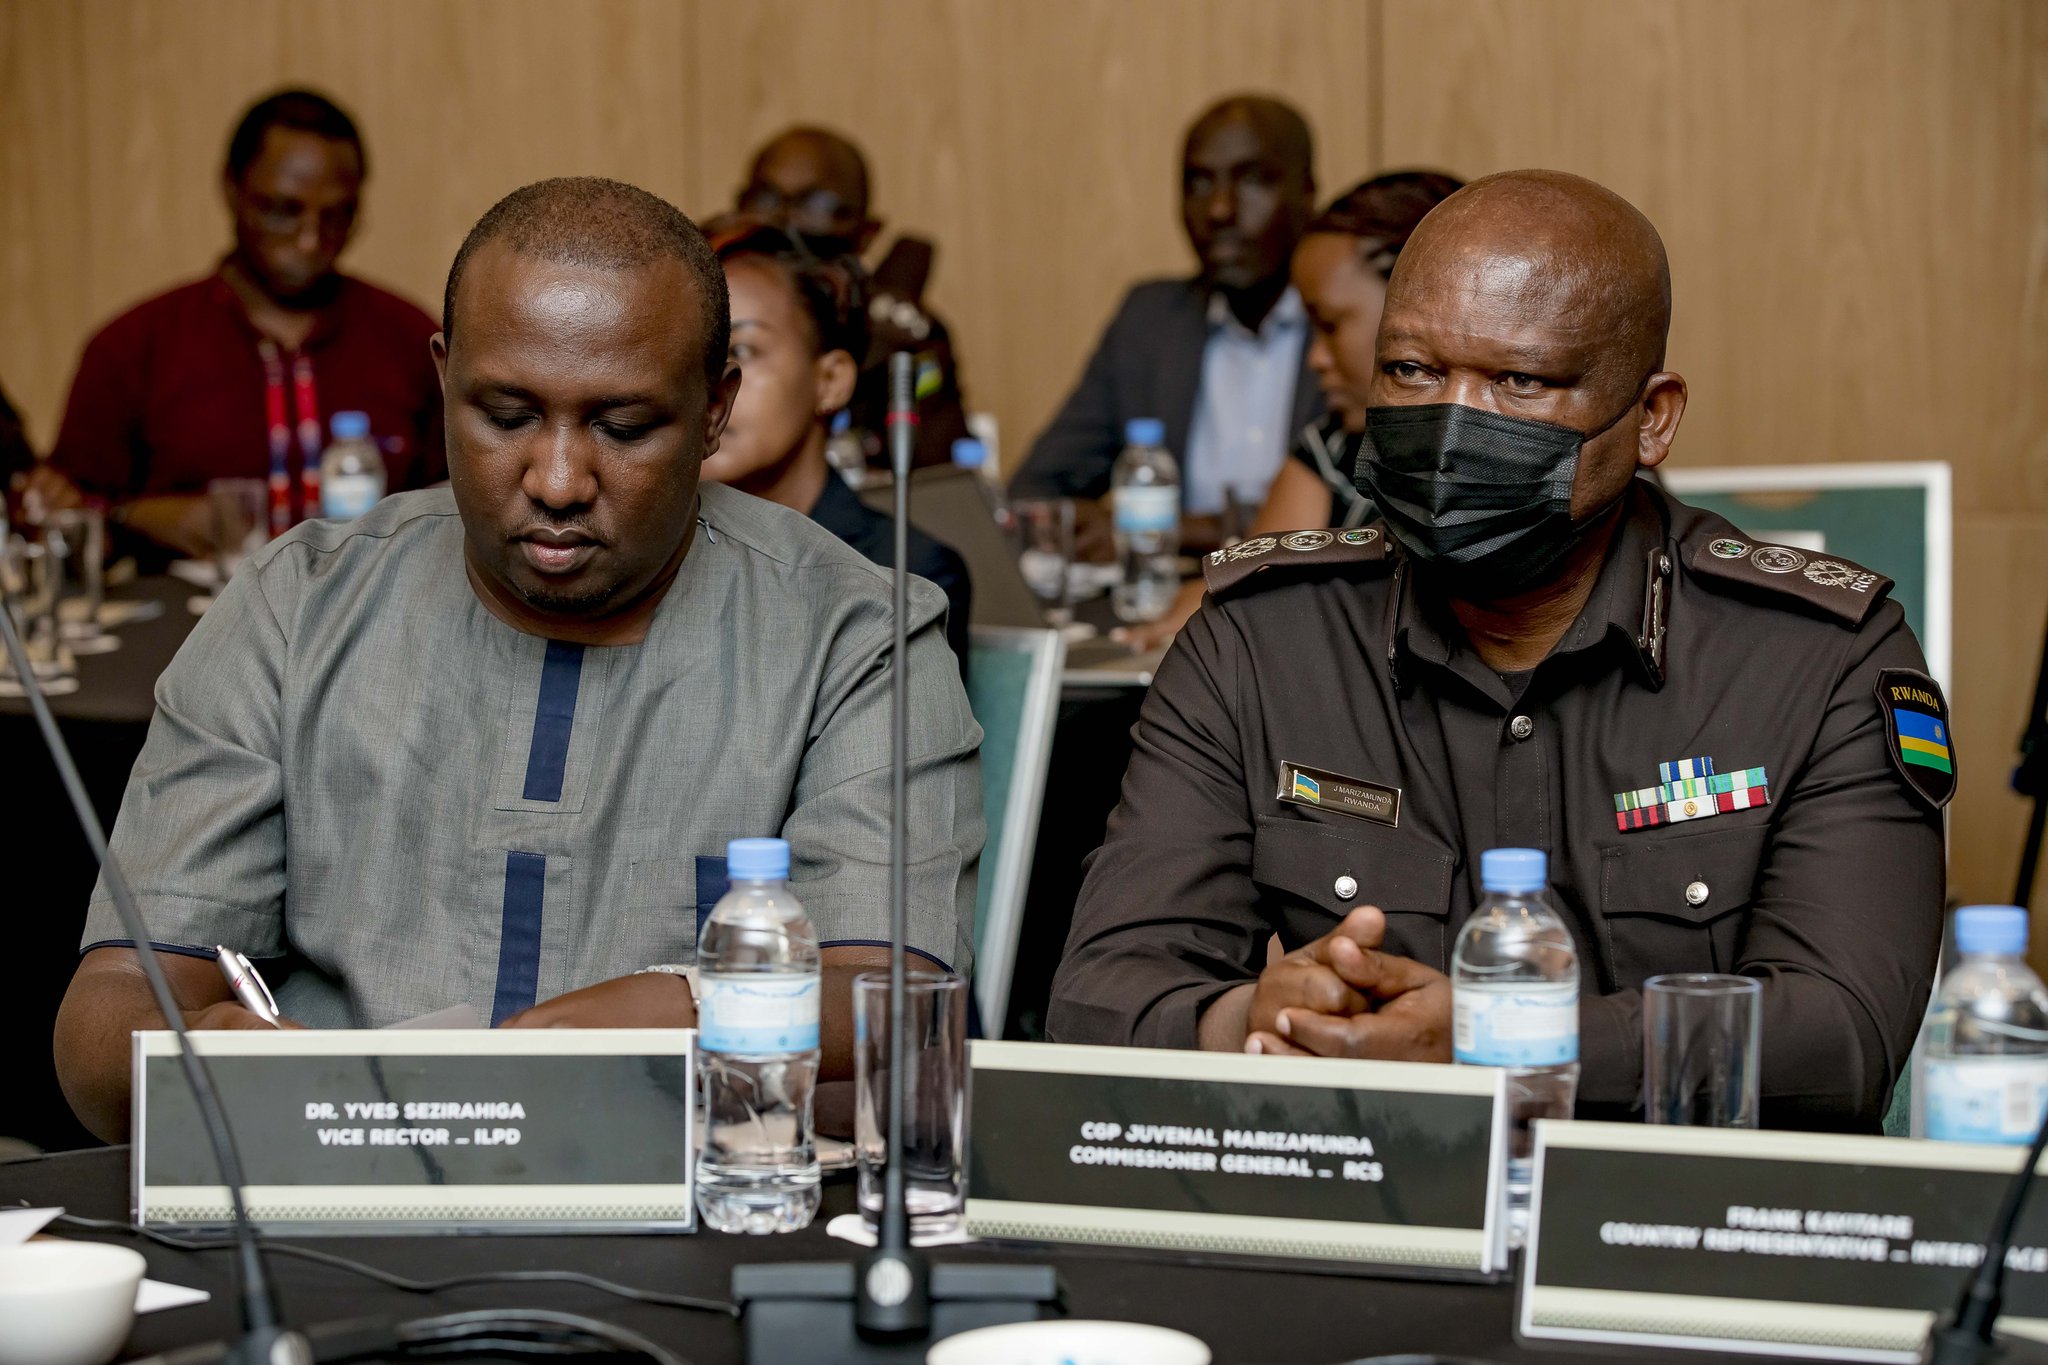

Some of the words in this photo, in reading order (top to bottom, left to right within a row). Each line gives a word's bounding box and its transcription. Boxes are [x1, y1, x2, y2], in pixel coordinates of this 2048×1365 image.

[1850, 573, 1878, 592] RCS
[1890, 686, 1940, 712] RWANDA
[1339, 786, 1392, 805] MARIZAMUNDA
[1344, 796, 1380, 811] RWANDA
[305, 1102, 339, 1120] DR.
[344, 1102, 399, 1120] YVES
[404, 1102, 526, 1120] SEZIRAHIGA
[317, 1128, 365, 1145] VICE
[370, 1128, 449, 1145] RECTOR
[474, 1128, 521, 1145] ILPD
[1081, 1121, 1122, 1141] CGP
[1125, 1123, 1219, 1147] JUVENAL
[1222, 1129, 1375, 1156] MARIZAMUNDA
[1069, 1145, 1217, 1172] COMMISSIONER
[1220, 1153, 1314, 1177] GENERAL
[1342, 1160, 1384, 1182] RCS
[1726, 1205, 1803, 1232] FRANK
[1600, 1221, 1701, 1249] COUNTRY
[1703, 1227, 1888, 1262] REPRESENTATIVE
